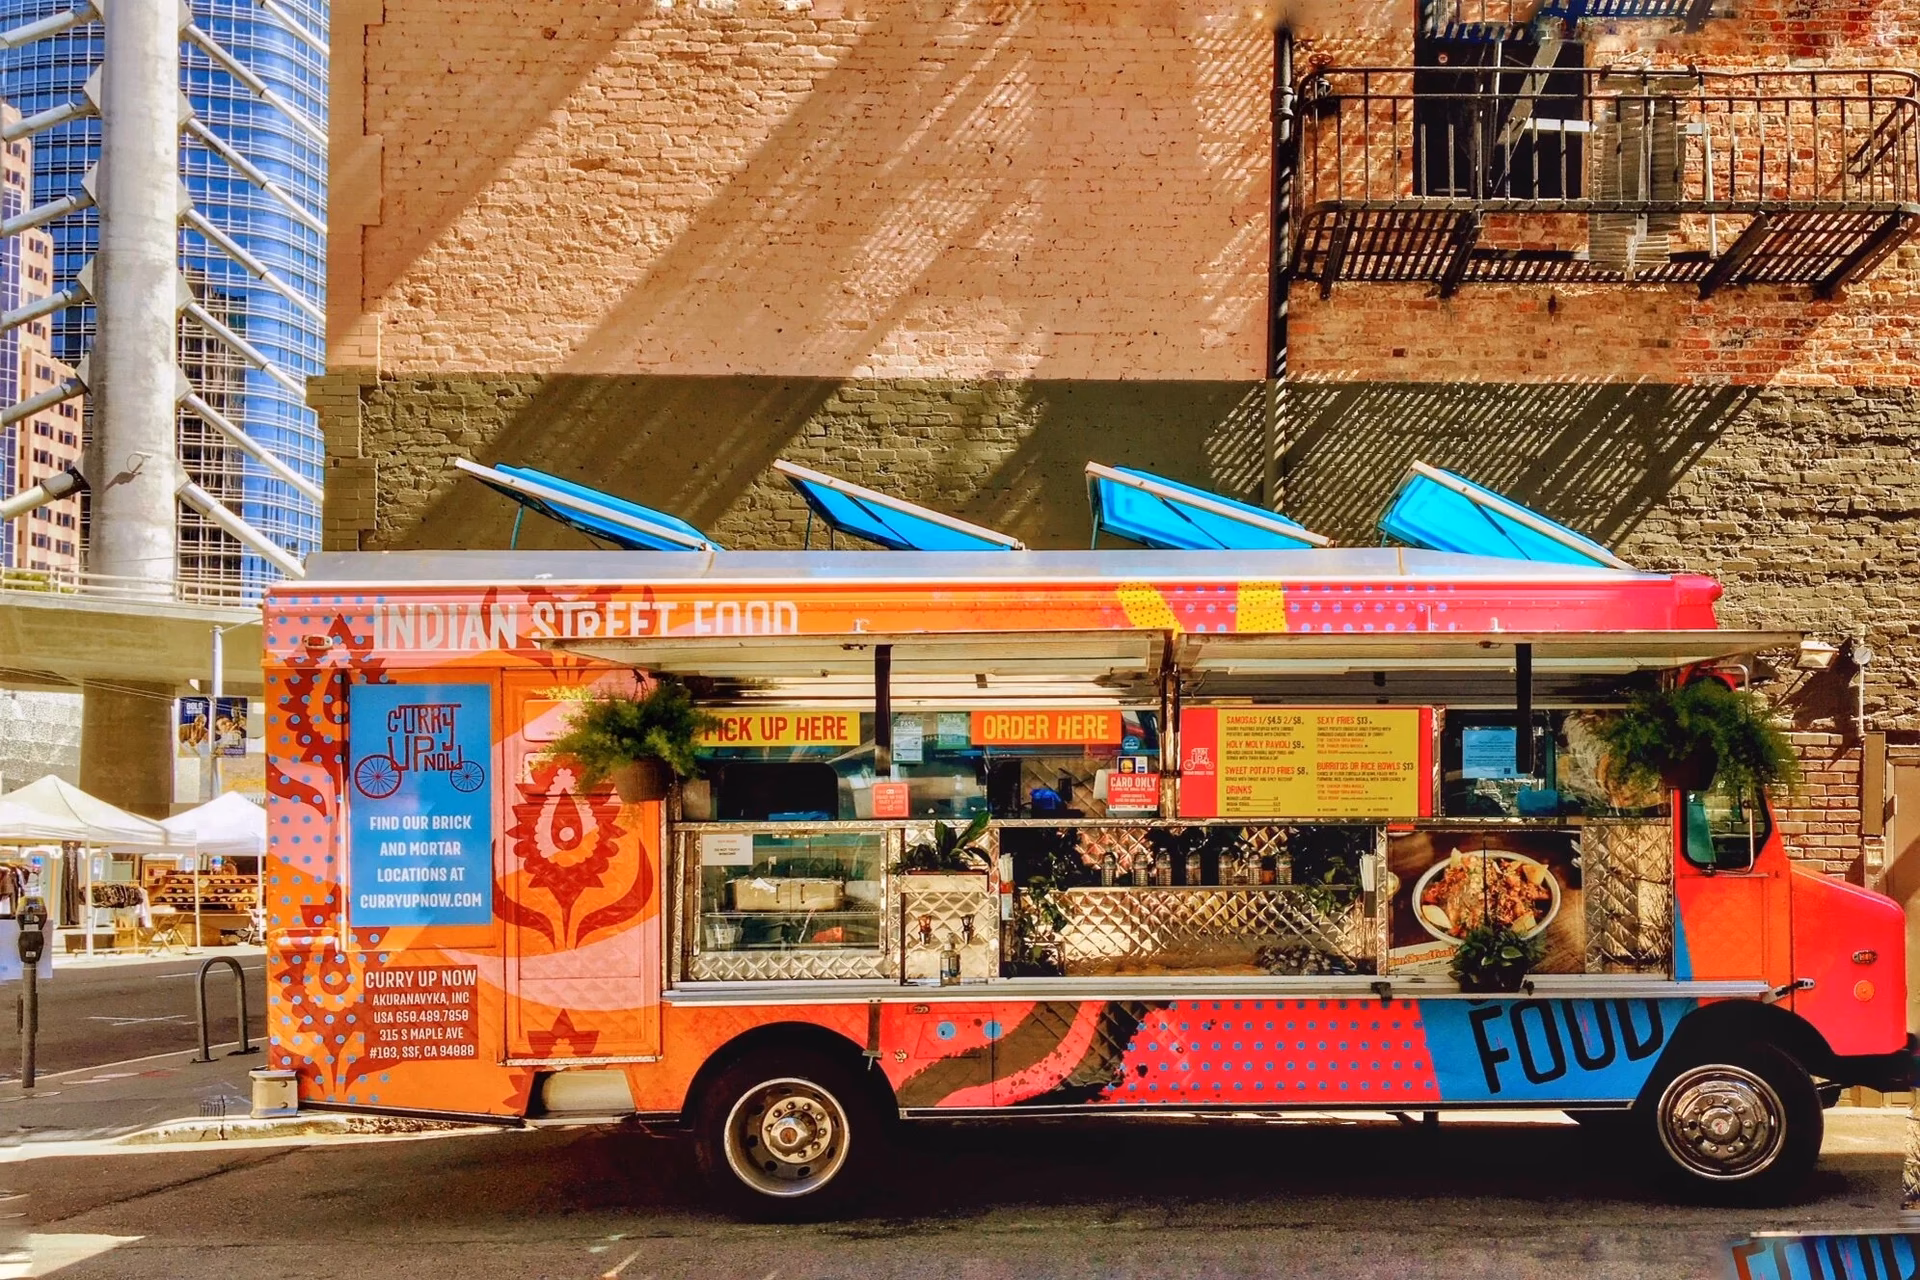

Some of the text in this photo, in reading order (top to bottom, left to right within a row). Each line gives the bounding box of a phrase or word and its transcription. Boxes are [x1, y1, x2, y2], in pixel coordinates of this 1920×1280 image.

[374, 603, 516, 649] INDIAN
[531, 601, 678, 639] STREET
[388, 704, 461, 751] CURRY
[761, 716, 788, 741] UP
[796, 715, 848, 741] HERE
[983, 714, 1049, 740] ORDER
[1057, 714, 1109, 740] HERE
[1226, 716, 1258, 725] SAMOSAS
[1317, 716, 1335, 725] SEXY
[1336, 716, 1355, 725] FRIES
[1226, 741, 1244, 749] HOLY
[1245, 741, 1263, 749] MOLY
[1265, 741, 1291, 749] RAVIOLI
[388, 735, 434, 772] UP
[424, 745, 462, 771] NOW
[1225, 766, 1248, 775] SWEET
[1249, 766, 1276, 775] POTATO
[1276, 766, 1295, 775] FRIES
[1316, 761, 1415, 771] BURRITOS OR RICE BOWLS $13
[1110, 777, 1157, 788] CARD ONLY
[1226, 785, 1252, 794] DRINKS
[370, 815, 472, 831] FIND OUR BRICK
[380, 841, 462, 857] AND MORTAR
[377, 867, 465, 883] LOCATIONS AT
[360, 893, 482, 909] CURRYUPNOW.COM
[365, 969, 477, 989] CURRY UP NOW
[372, 992, 470, 1006] AKURANAVYKA, INC
[374, 1009, 469, 1024] USA 650.489.7850
[379, 1027, 464, 1041] 315 S MAPLE AVE
[369, 1044, 475, 1060] #103, SSF, CA 94080
[1468, 998, 1664, 1094] FOOD
